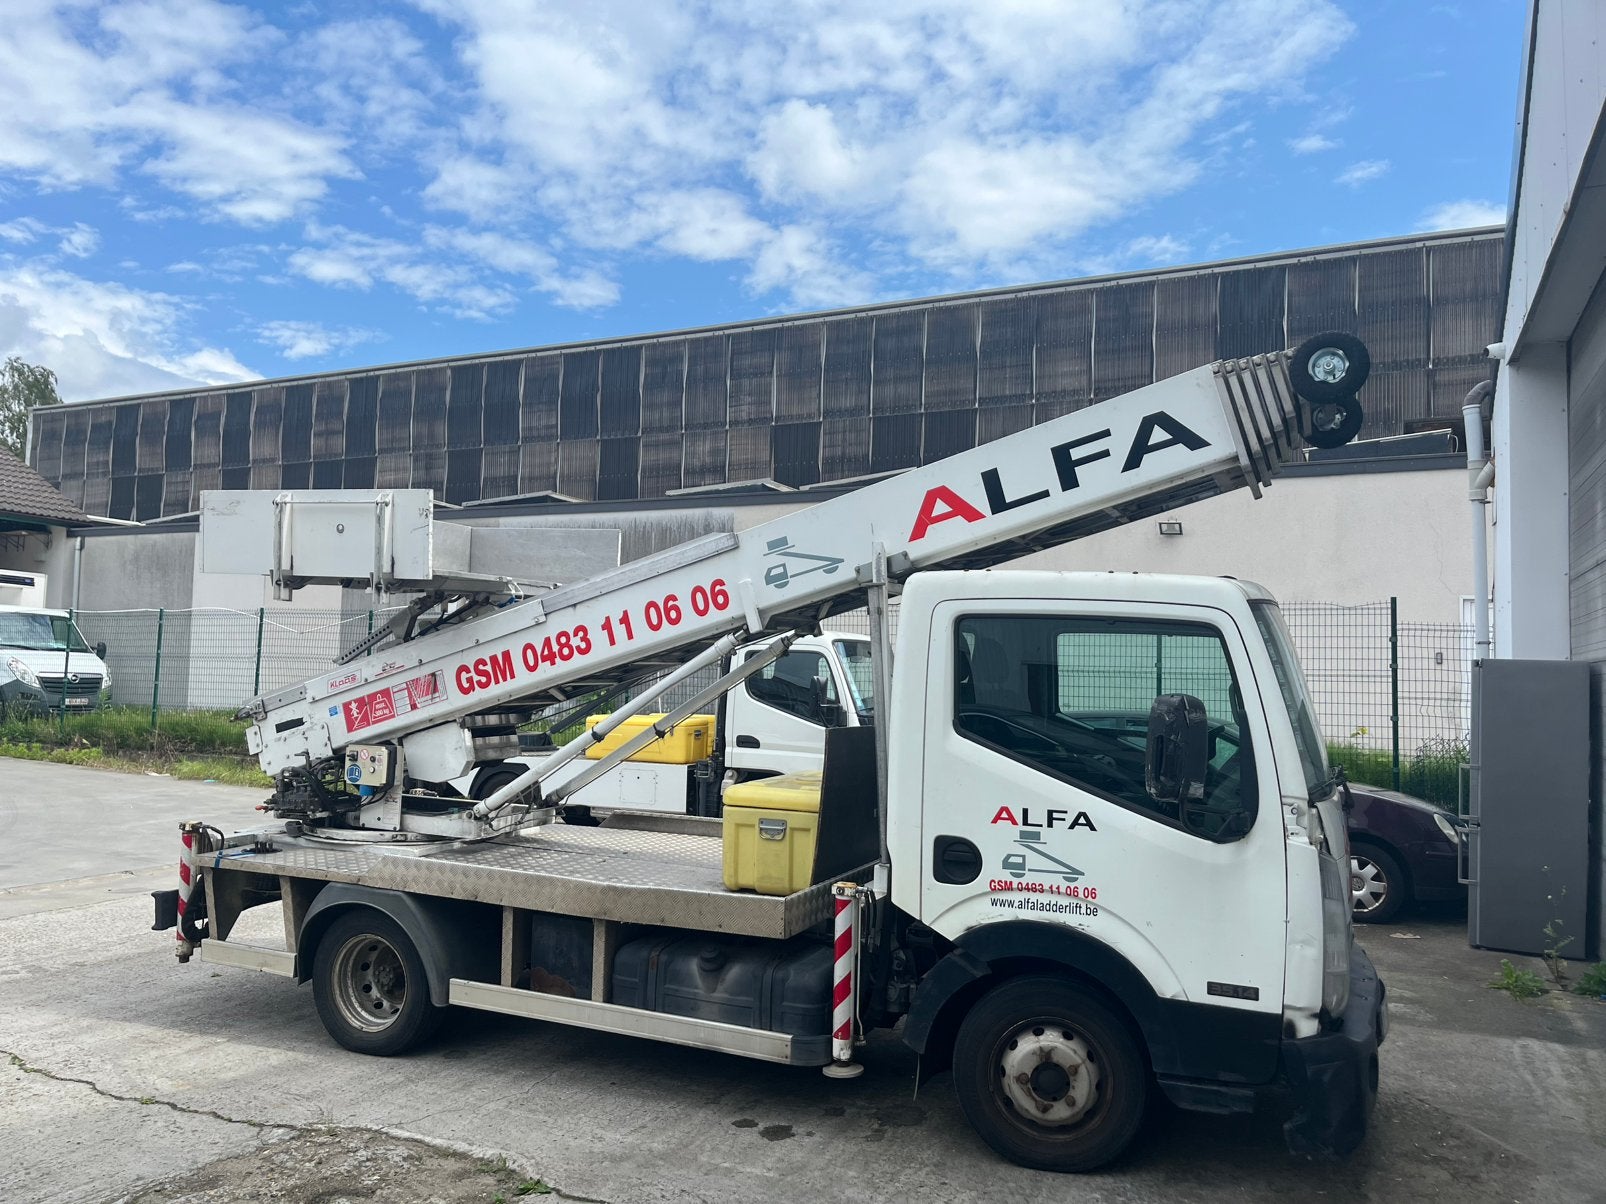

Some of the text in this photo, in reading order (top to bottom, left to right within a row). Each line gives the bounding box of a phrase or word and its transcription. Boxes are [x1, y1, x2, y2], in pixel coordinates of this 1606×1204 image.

[908, 410, 1212, 543] ALFA
[455, 649, 516, 696] GSM
[522, 624, 592, 673] 0483
[601, 609, 634, 647] 11
[644, 593, 682, 632] 06
[690, 578, 730, 617] 06
[990, 805, 1098, 832] ALFA
[989, 879, 1097, 900] GSM 0483 11 06 06
[990, 897, 1098, 917] www.alfaladderlift.be
